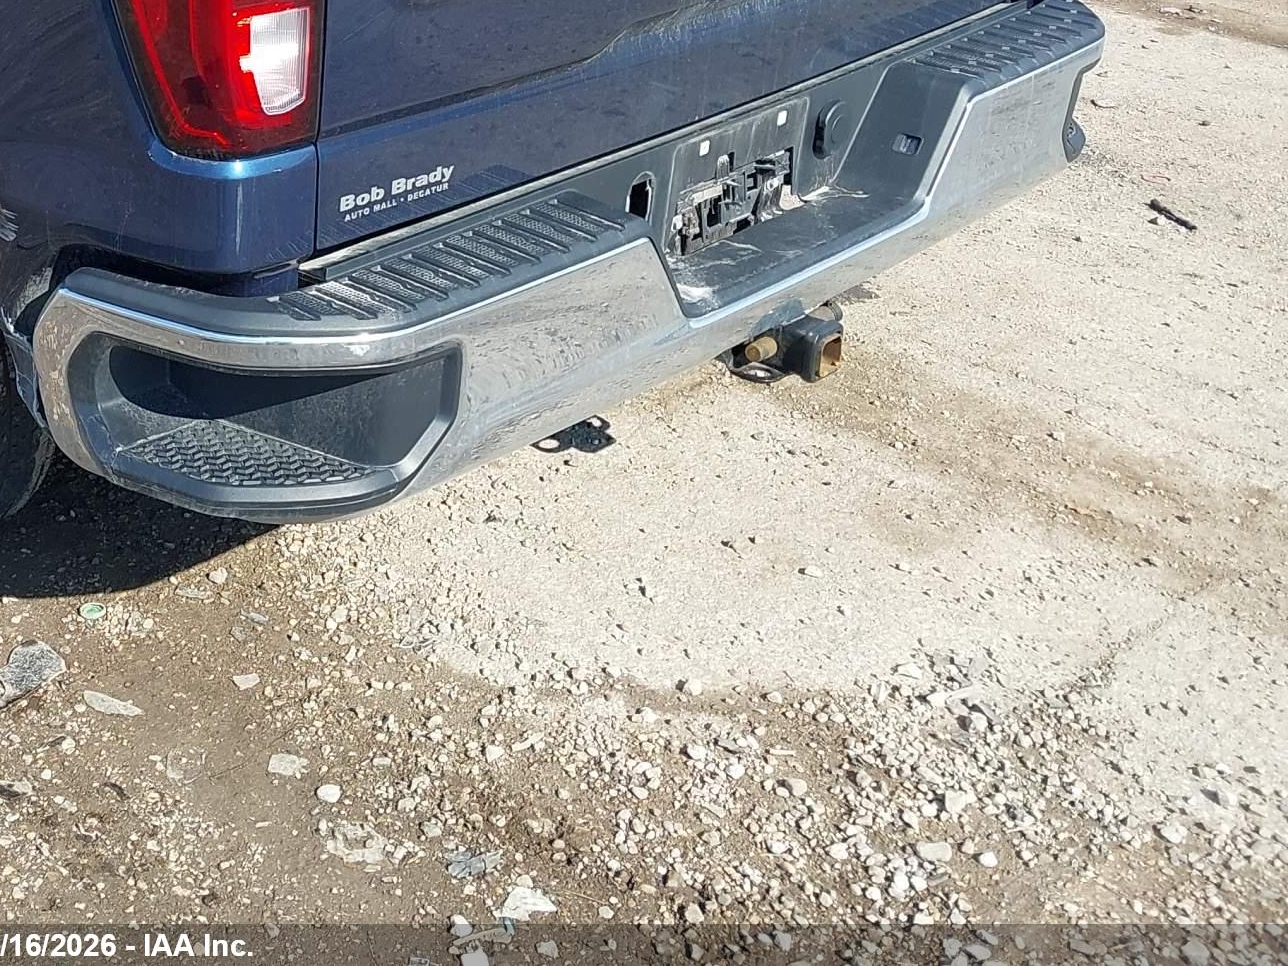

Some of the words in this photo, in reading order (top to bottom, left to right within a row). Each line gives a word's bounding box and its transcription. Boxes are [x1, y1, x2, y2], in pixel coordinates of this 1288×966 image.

[339, 186, 385, 212] Bob
[391, 165, 455, 195] Brady
[344, 207, 370, 222] AUTO
[373, 199, 397, 212] MALL
[407, 182, 449, 202] DECATUR
